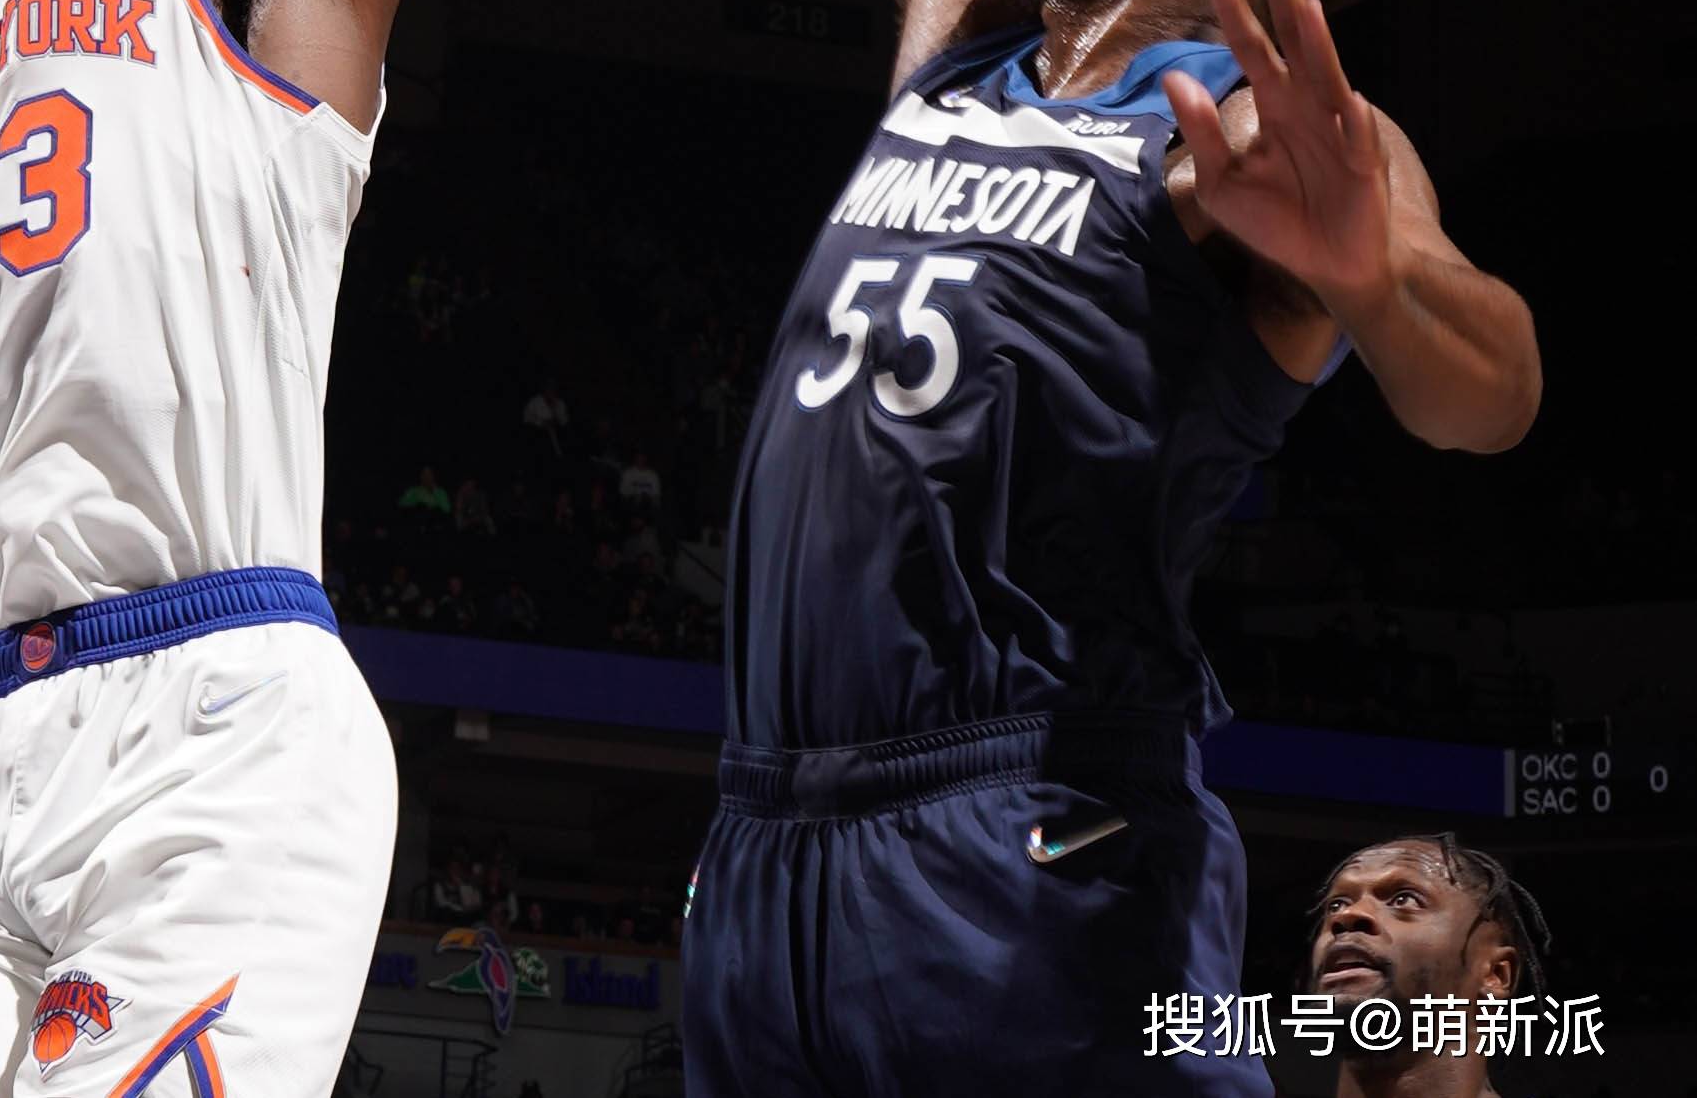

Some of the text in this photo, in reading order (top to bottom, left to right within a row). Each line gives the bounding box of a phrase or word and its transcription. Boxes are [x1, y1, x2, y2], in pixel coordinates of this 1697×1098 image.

[766, 1, 831, 38] 218
[829, 154, 1096, 257] MINNESOTA
[794, 250, 985, 420] 55
[1521, 750, 1612, 782] OKC 0
[1649, 764, 1669, 793] 0
[1521, 784, 1612, 816] SAC 0
[561, 955, 660, 1009] Island
